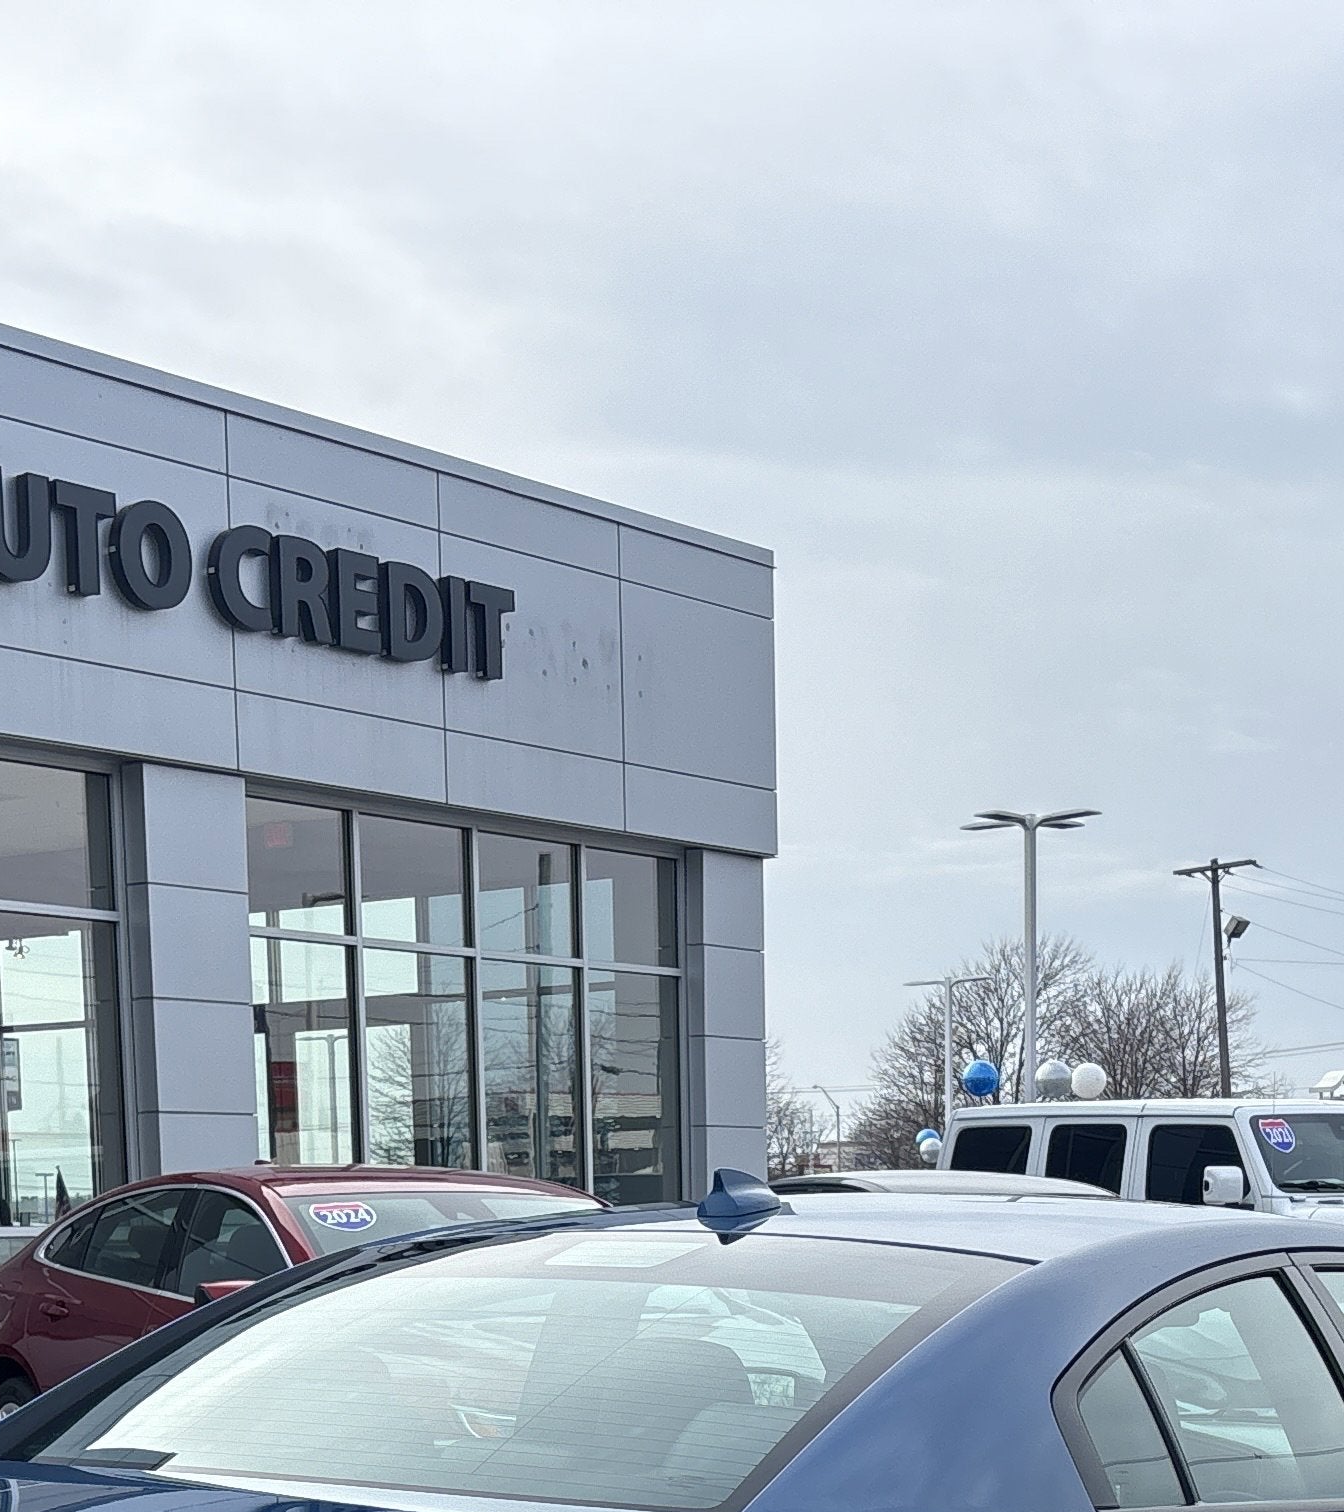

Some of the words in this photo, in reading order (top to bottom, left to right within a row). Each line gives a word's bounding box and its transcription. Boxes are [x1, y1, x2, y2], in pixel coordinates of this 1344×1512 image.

[207, 524, 515, 680] CREDIT
[1265, 1127, 1293, 1143] 2021
[319, 1208, 372, 1224] 2024
